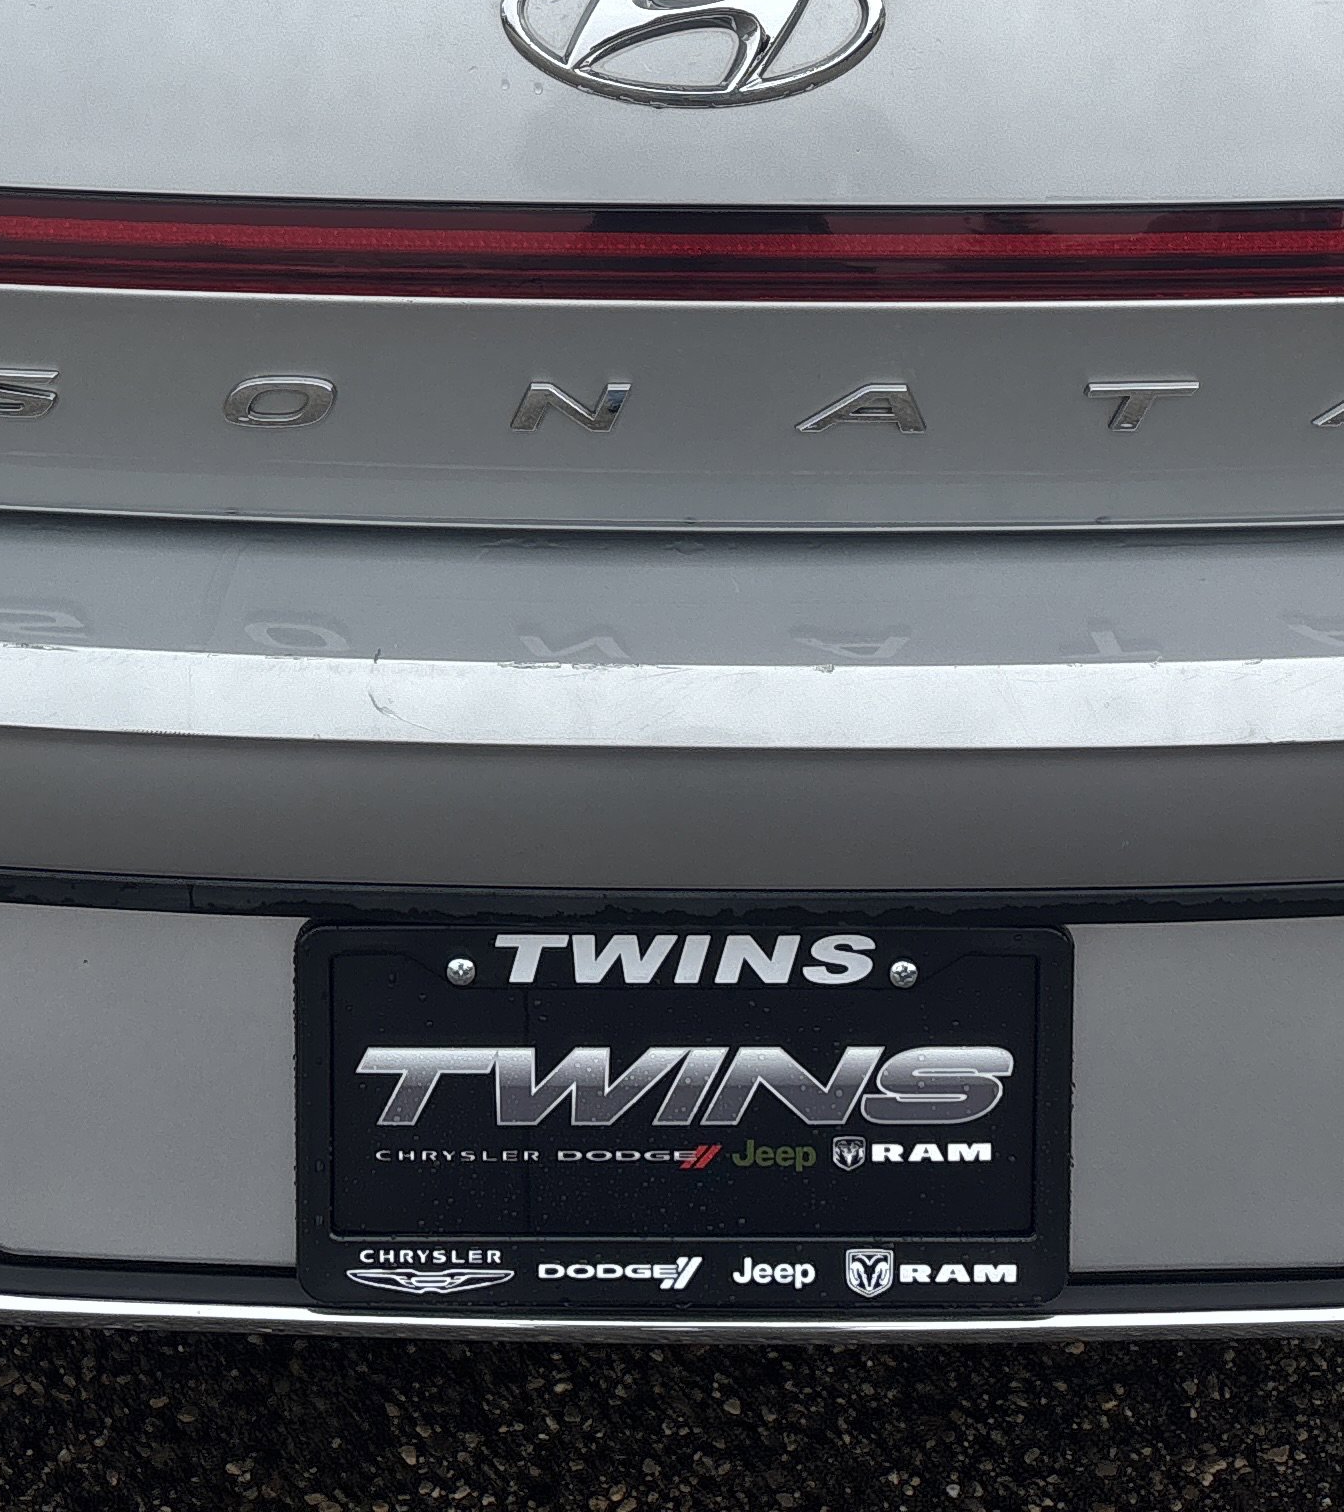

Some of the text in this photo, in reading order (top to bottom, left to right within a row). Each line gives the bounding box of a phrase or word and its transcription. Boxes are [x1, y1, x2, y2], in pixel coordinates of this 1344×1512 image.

[494, 934, 877, 985] TWINS
[355, 1046, 1014, 1126] TWINS
[375, 1139, 992, 1172] CHRYSLER DODGE Jeep RAM
[359, 1249, 502, 1265] CHRYSLER
[538, 1256, 1018, 1289] DODGE Jeep RAM
